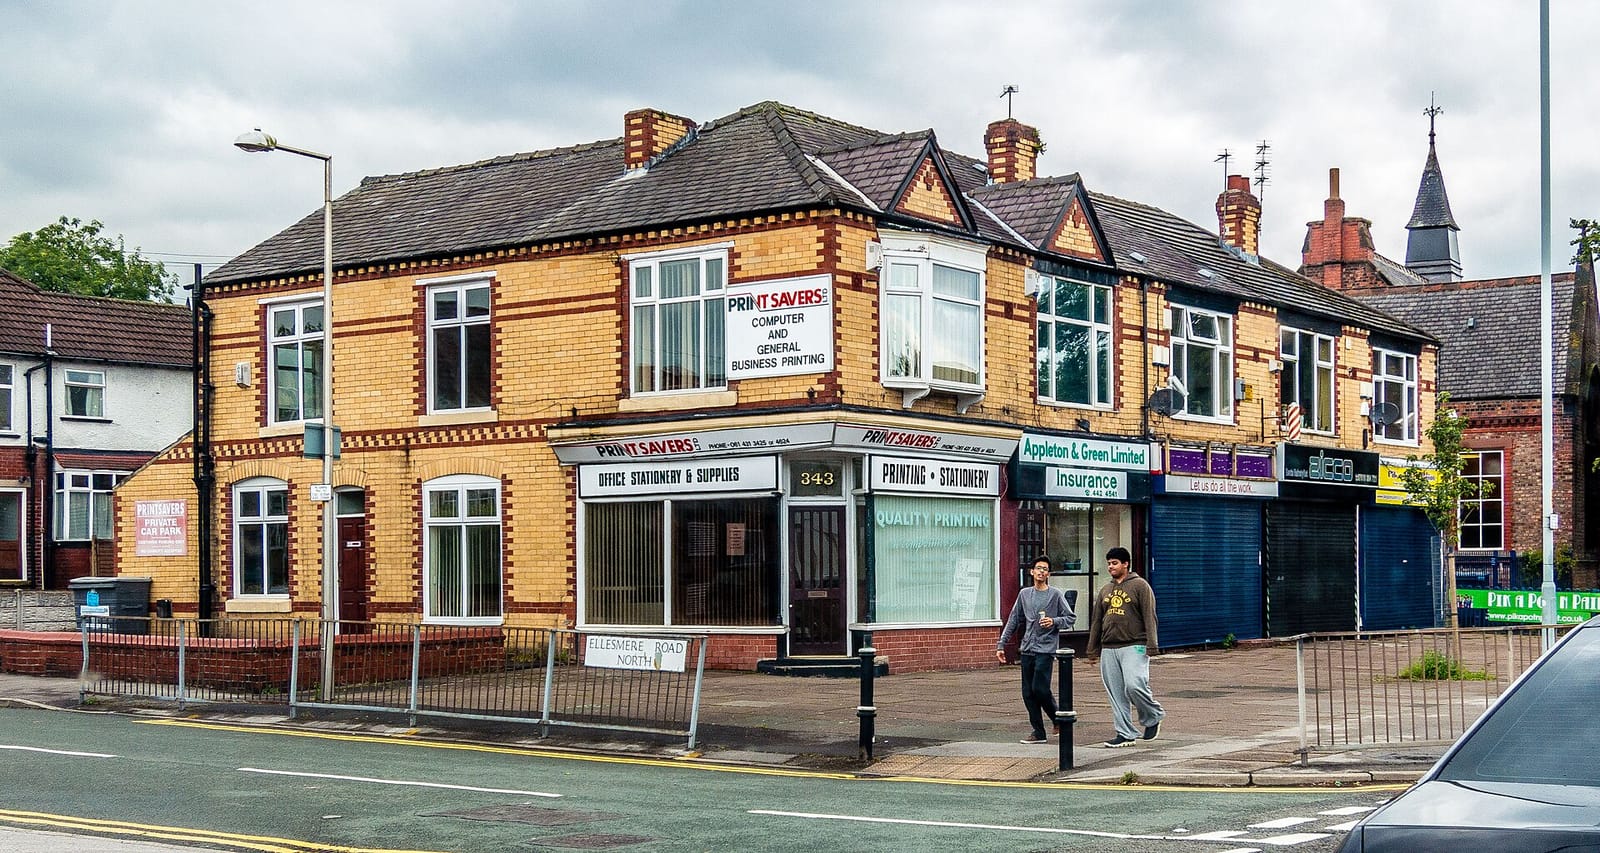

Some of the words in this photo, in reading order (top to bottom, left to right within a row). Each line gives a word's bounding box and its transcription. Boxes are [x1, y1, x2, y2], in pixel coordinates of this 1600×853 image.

[752, 313, 804, 328] COMPUTER
[768, 329, 788, 339] AND
[757, 342, 801, 354] GENERAL
[732, 358, 777, 371] BUSINESS
[781, 354, 825, 367] PRINTING
[1024, 438, 1068, 461] Appleton
[1071, 442, 1079, 459] &
[1081, 443, 1108, 460] Green
[1111, 446, 1144, 464] Limited
[599, 472, 625, 487] OFFICE
[630, 469, 682, 486] STATIONERY
[686, 469, 692, 483] &
[697, 467, 740, 482] SUPPLIES
[801, 472, 834, 485] 343
[882, 463, 926, 485] PRINTING
[940, 467, 989, 488] STATIONERY
[1056, 469, 1118, 489] Insurance
[1190, 479, 1200, 491] Let
[1202, 482, 1209, 491] us
[1210, 480, 1219, 492] do
[1227, 480, 1237, 493] the
[137, 503, 184, 516] PRINTSAVERS
[144, 518, 177, 527] PRIVATE
[877, 512, 929, 527] QUALITY
[935, 513, 990, 528] PRINTING
[141, 528, 158, 536] CAR
[160, 527, 181, 536] PARK
[1487, 592, 1511, 607] PIK
[1515, 595, 1524, 608] A
[589, 639, 644, 652] ELLESMERE
[655, 641, 683, 654] ROAD
[617, 655, 651, 667] NORTH
